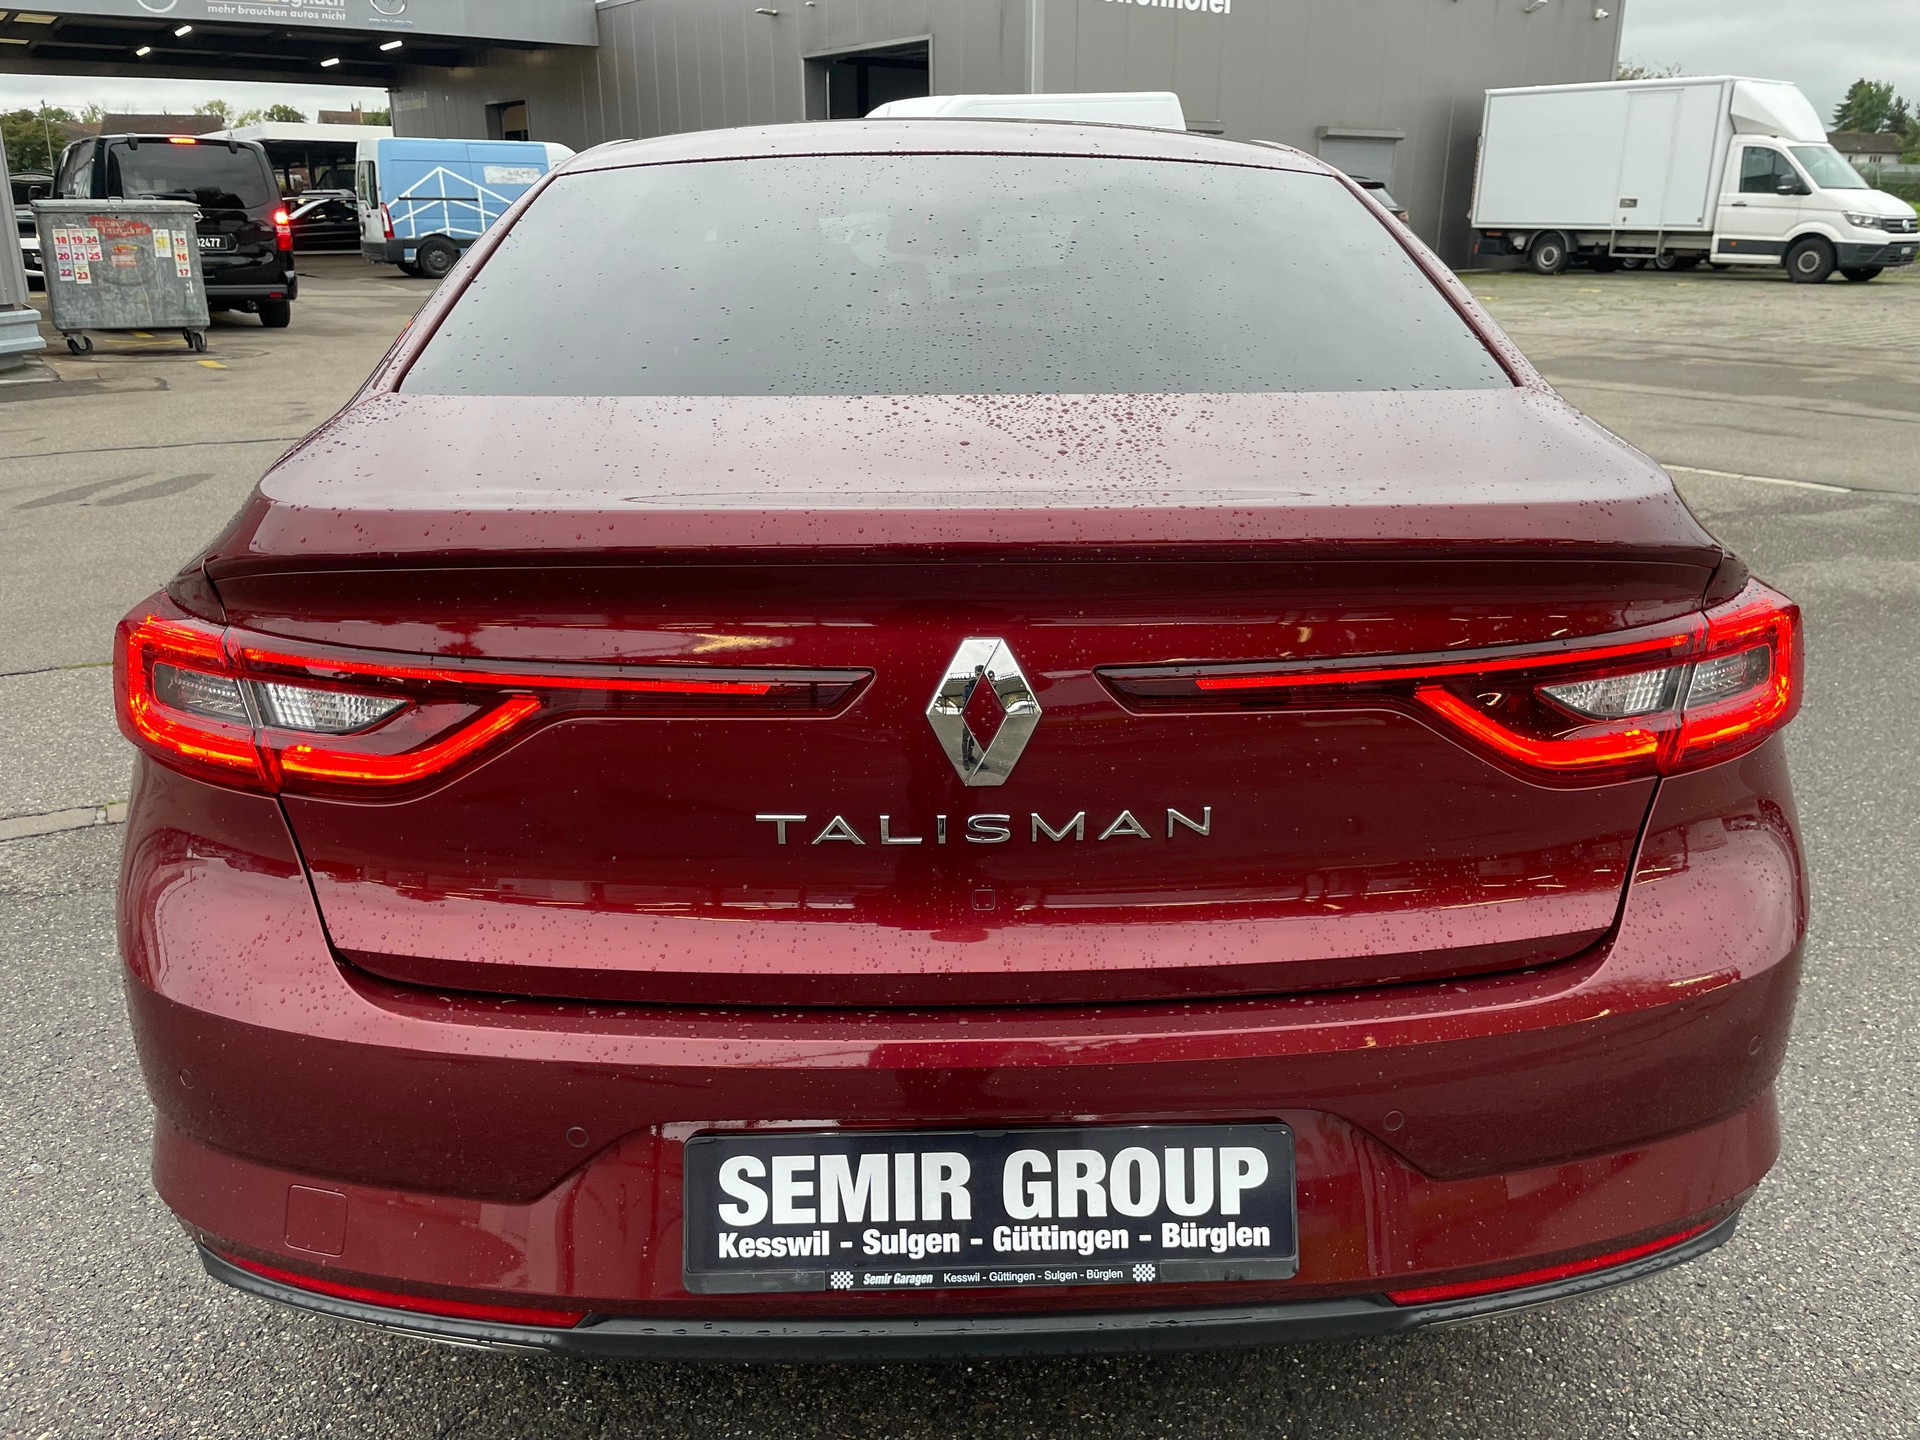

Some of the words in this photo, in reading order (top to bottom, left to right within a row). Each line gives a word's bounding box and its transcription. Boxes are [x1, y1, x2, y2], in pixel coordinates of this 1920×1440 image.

[207, 4, 236, 14] mehr
[237, 5, 288, 17] brauchen
[290, 9, 319, 19] autos
[321, 11, 346, 21] nicht
[55, 236, 67, 244] 18
[71, 236, 83, 244] 19
[85, 236, 97, 244] 24
[57, 252, 70, 260] 20
[73, 252, 86, 260] 21
[88, 252, 101, 260] 25
[177, 253, 187, 261] 16
[60, 268, 72, 277] 22
[77, 271, 88, 279] 23
[178, 268, 189, 276] 17
[755, 806, 1211, 846] TALISMAN
[718, 1152, 972, 1227] SEMIR
[1003, 1146, 1269, 1220] GROUP
[718, 1230, 830, 1259] Kesswil
[862, 1228, 960, 1260] Sulgen
[993, 1225, 1129, 1255] Güttingen
[1162, 1221, 1270, 1253] Bürglen
[863, 1273, 892, 1286] Semir
[893, 1272, 934, 1286] Garagen
[943, 1272, 980, 1284] Kesswil
[989, 1270, 1036, 1283] Güttingen
[1044, 1270, 1078, 1283] Sulgen
[1086, 1268, 1123, 1281] Bürglen
